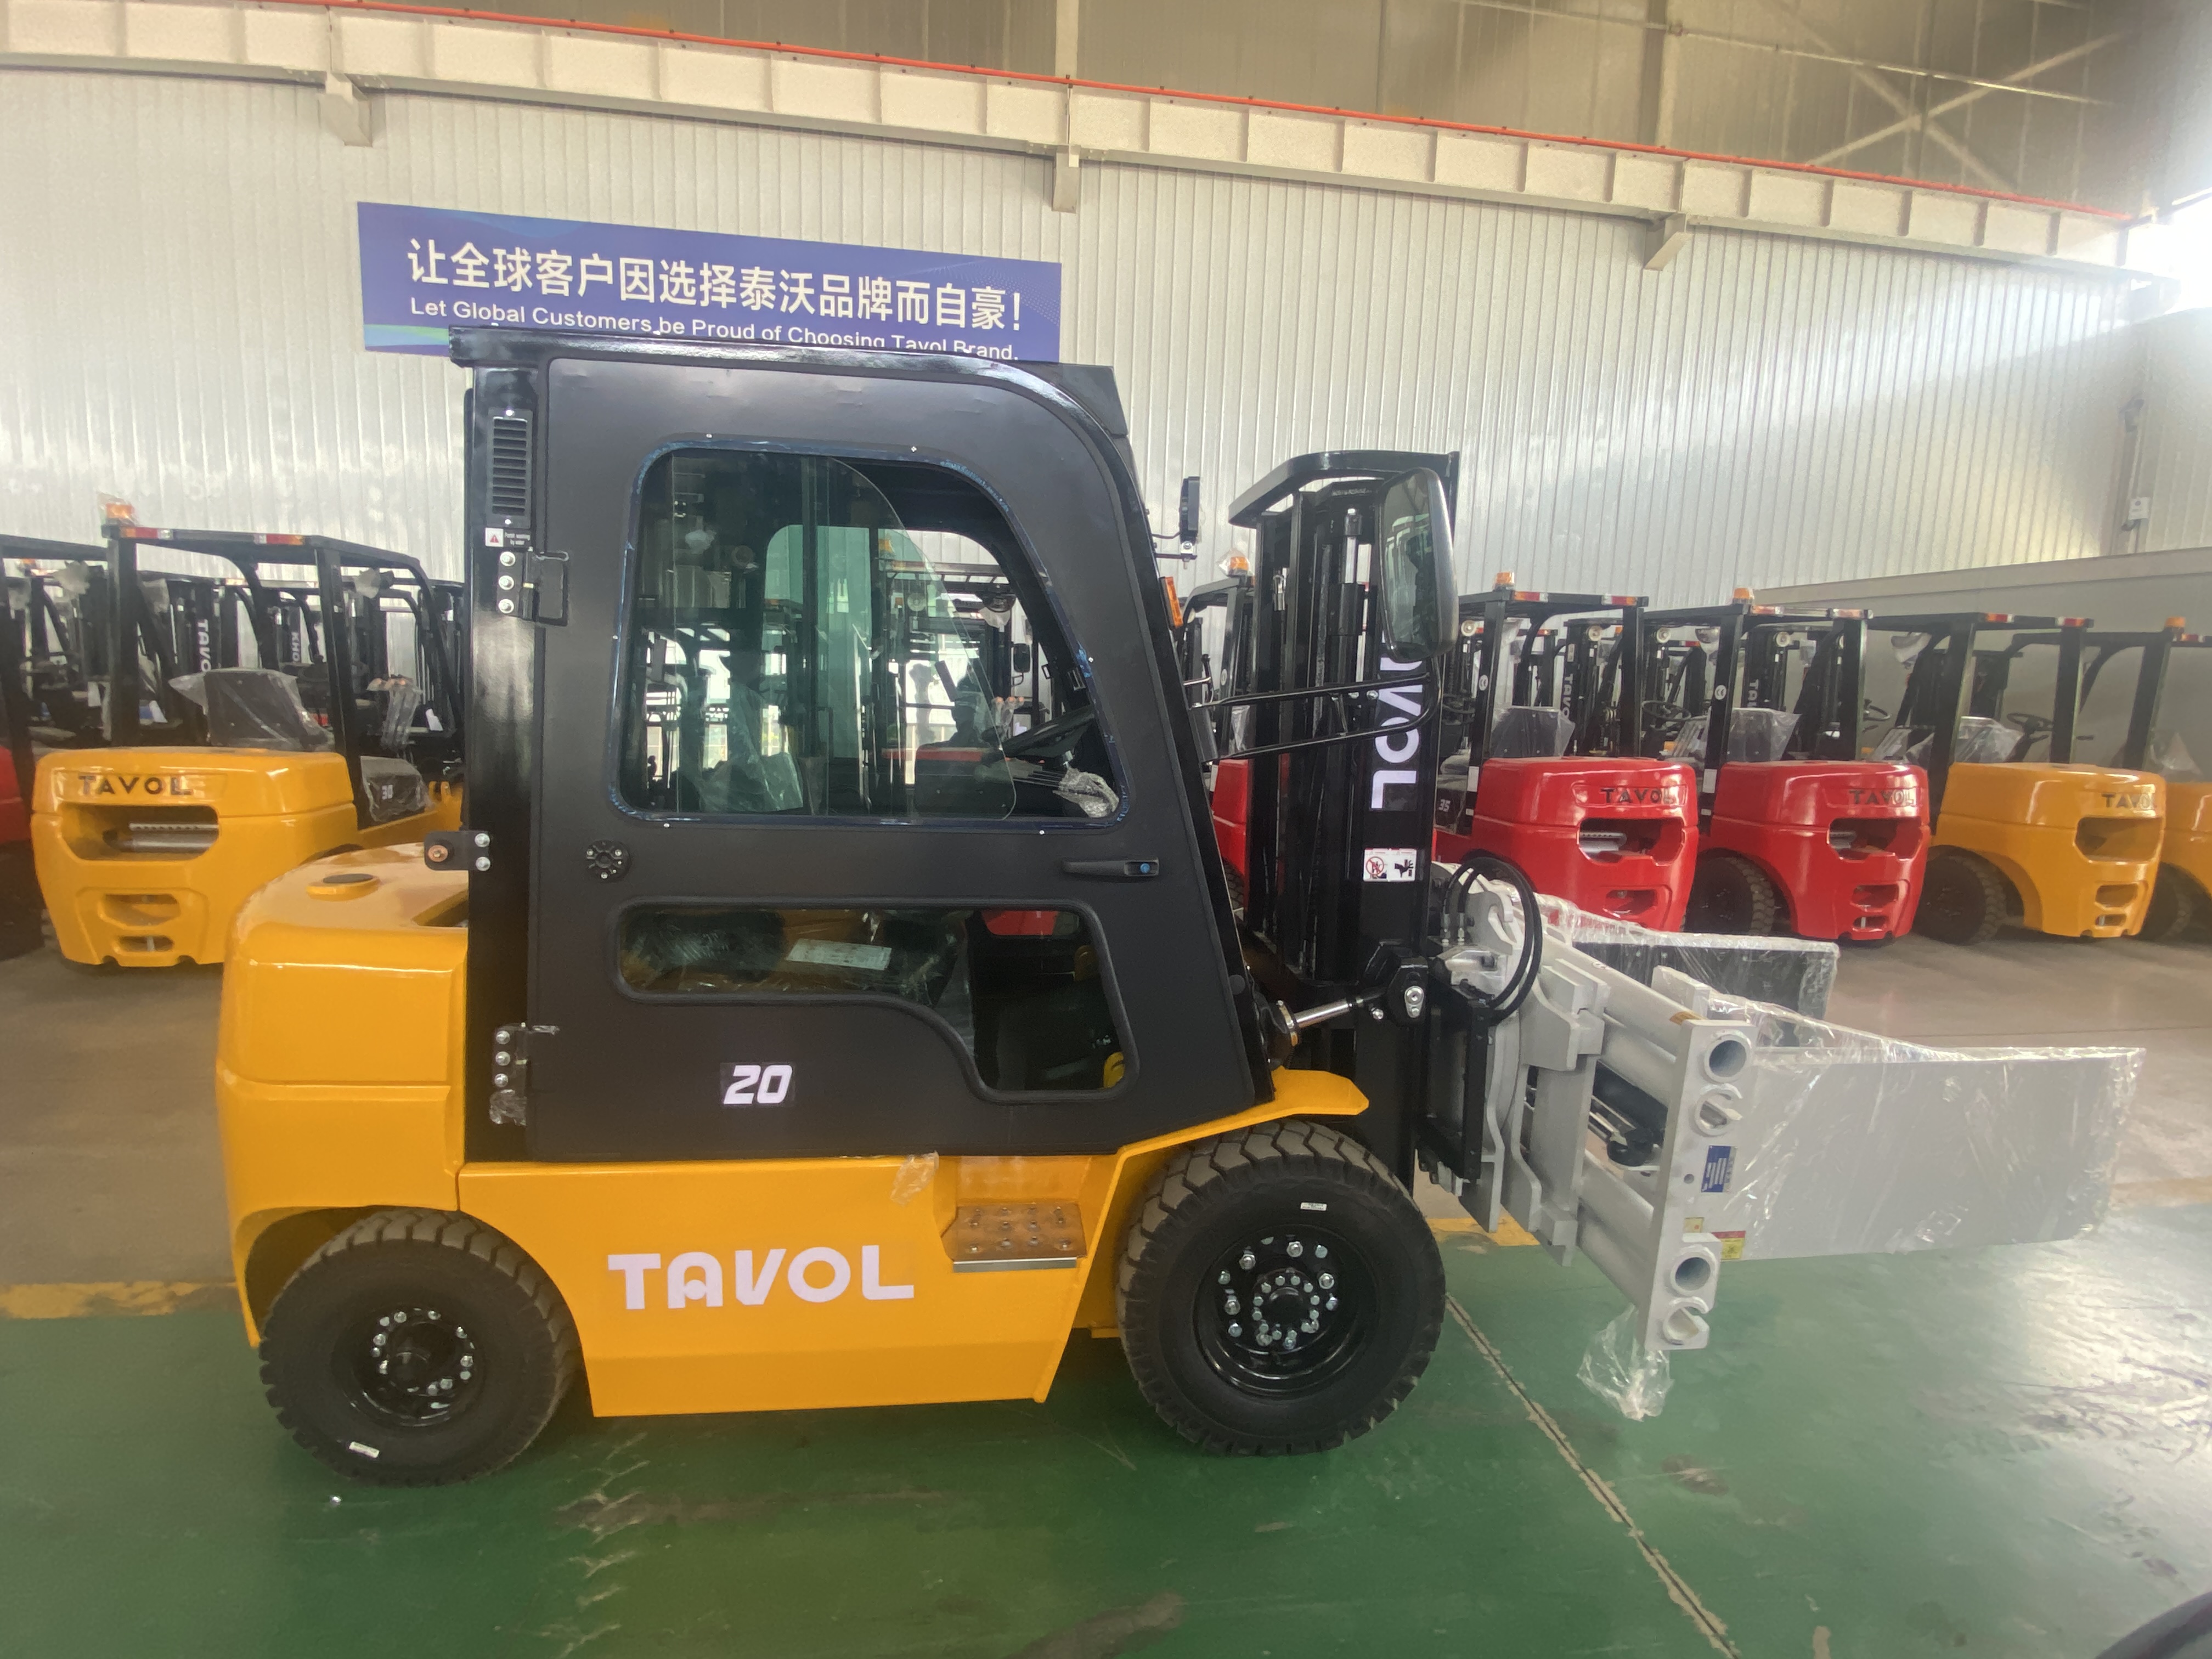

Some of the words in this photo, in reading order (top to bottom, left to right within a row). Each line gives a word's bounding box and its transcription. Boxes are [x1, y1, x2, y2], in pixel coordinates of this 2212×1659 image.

[407, 238, 1020, 331] 让全球客户因选择泰沃品牌而自豪！
[411, 297, 447, 317] Let
[453, 301, 525, 323] Global
[532, 307, 652, 332] Customers
[659, 317, 685, 334] be
[692, 319, 755, 339] Proud
[761, 325, 782, 341] of
[891, 335, 946, 351] Tavol
[1371, 630, 1423, 809] VOL
[78, 774, 193, 795] TAVOL
[1600, 787, 1677, 804] TAVOL
[1849, 789, 1915, 805] TAVOL
[1438, 799, 1451, 812] 35
[2101, 793, 2158, 810] TAVO
[723, 1064, 793, 1104] 20
[607, 1244, 915, 1310] TAVOL
